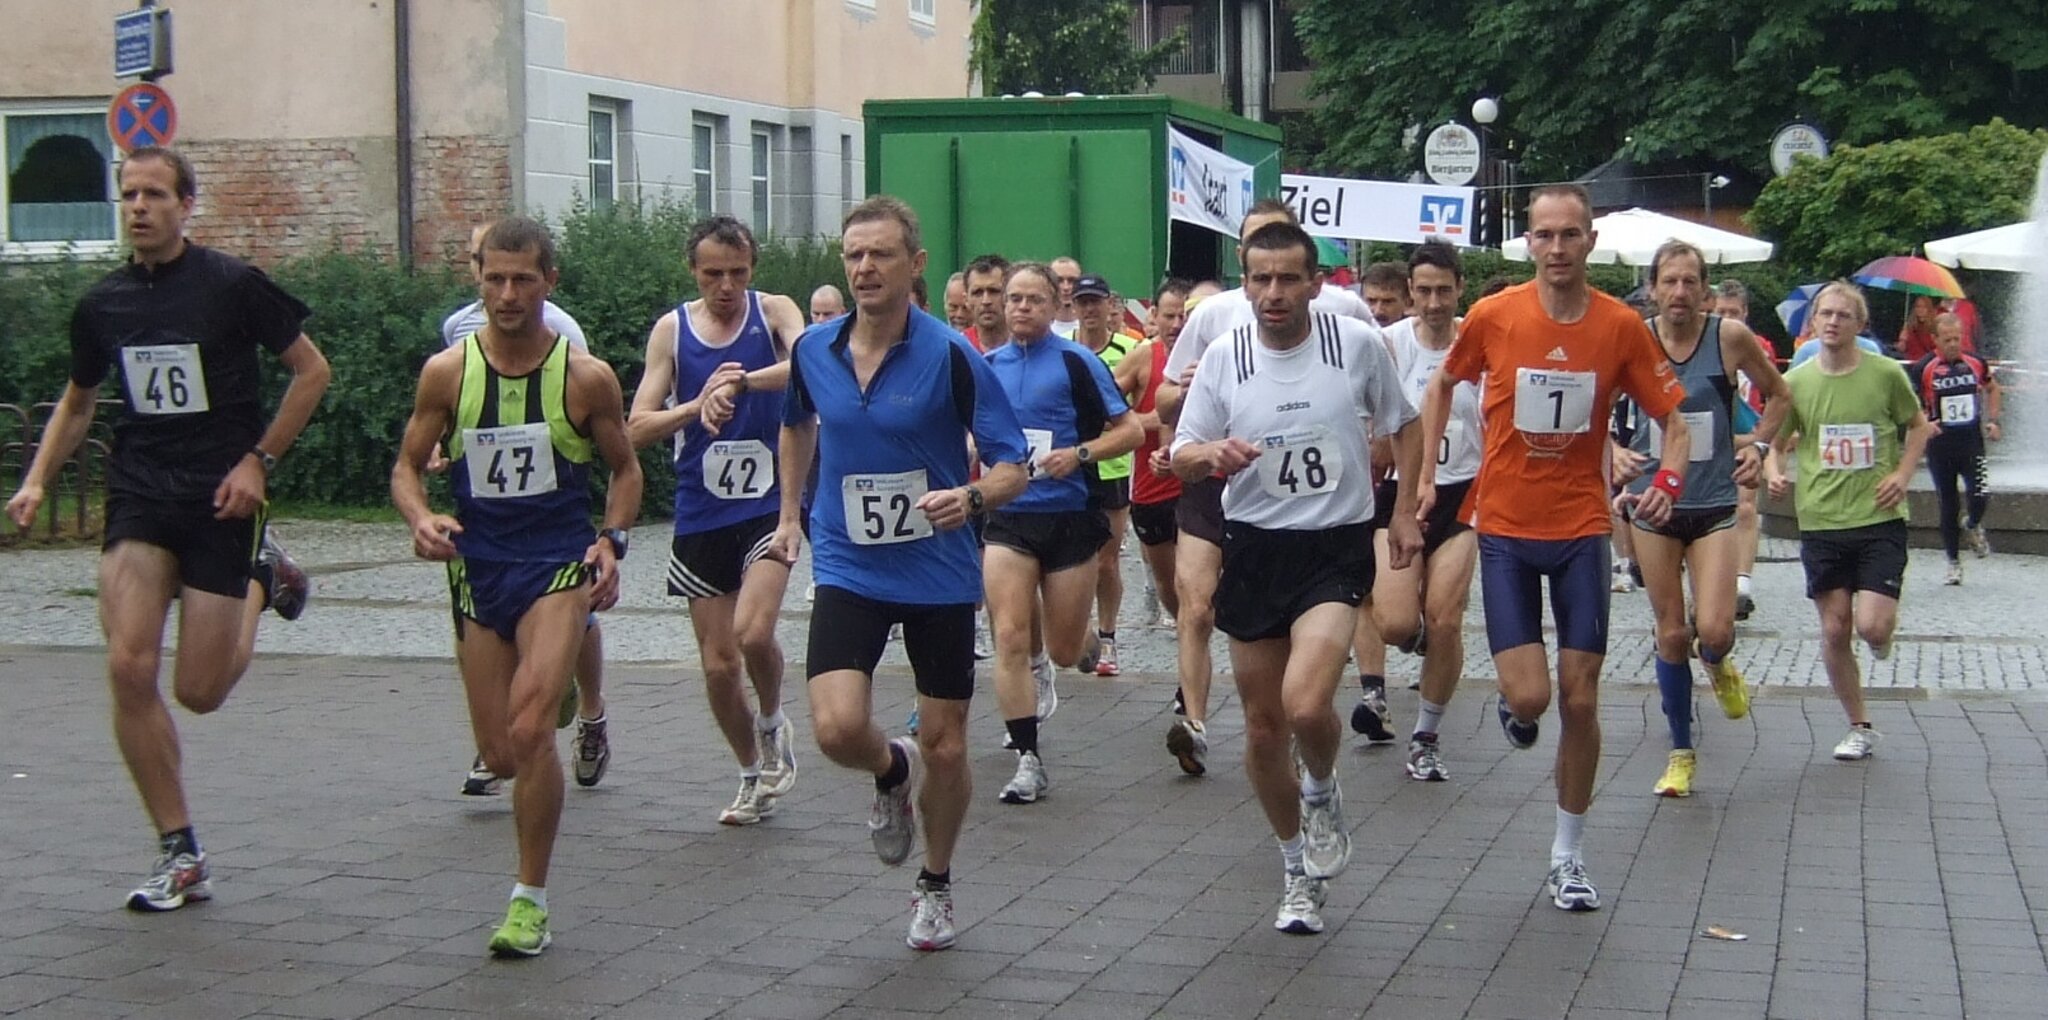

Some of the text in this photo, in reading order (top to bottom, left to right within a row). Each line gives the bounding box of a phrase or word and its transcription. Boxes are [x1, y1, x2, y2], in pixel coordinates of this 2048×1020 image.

[1280, 184, 1344, 227] Ziel
[146, 366, 189, 409] 46
[1276, 401, 1310, 413] adidas
[1548, 390, 1563, 429] 1
[1947, 403, 1968, 420] 34
[487, 446, 535, 493] 47
[1278, 446, 1327, 493] 48
[1823, 437, 1872, 466] 401
[718, 457, 759, 495] 42
[862, 494, 914, 539] 52
